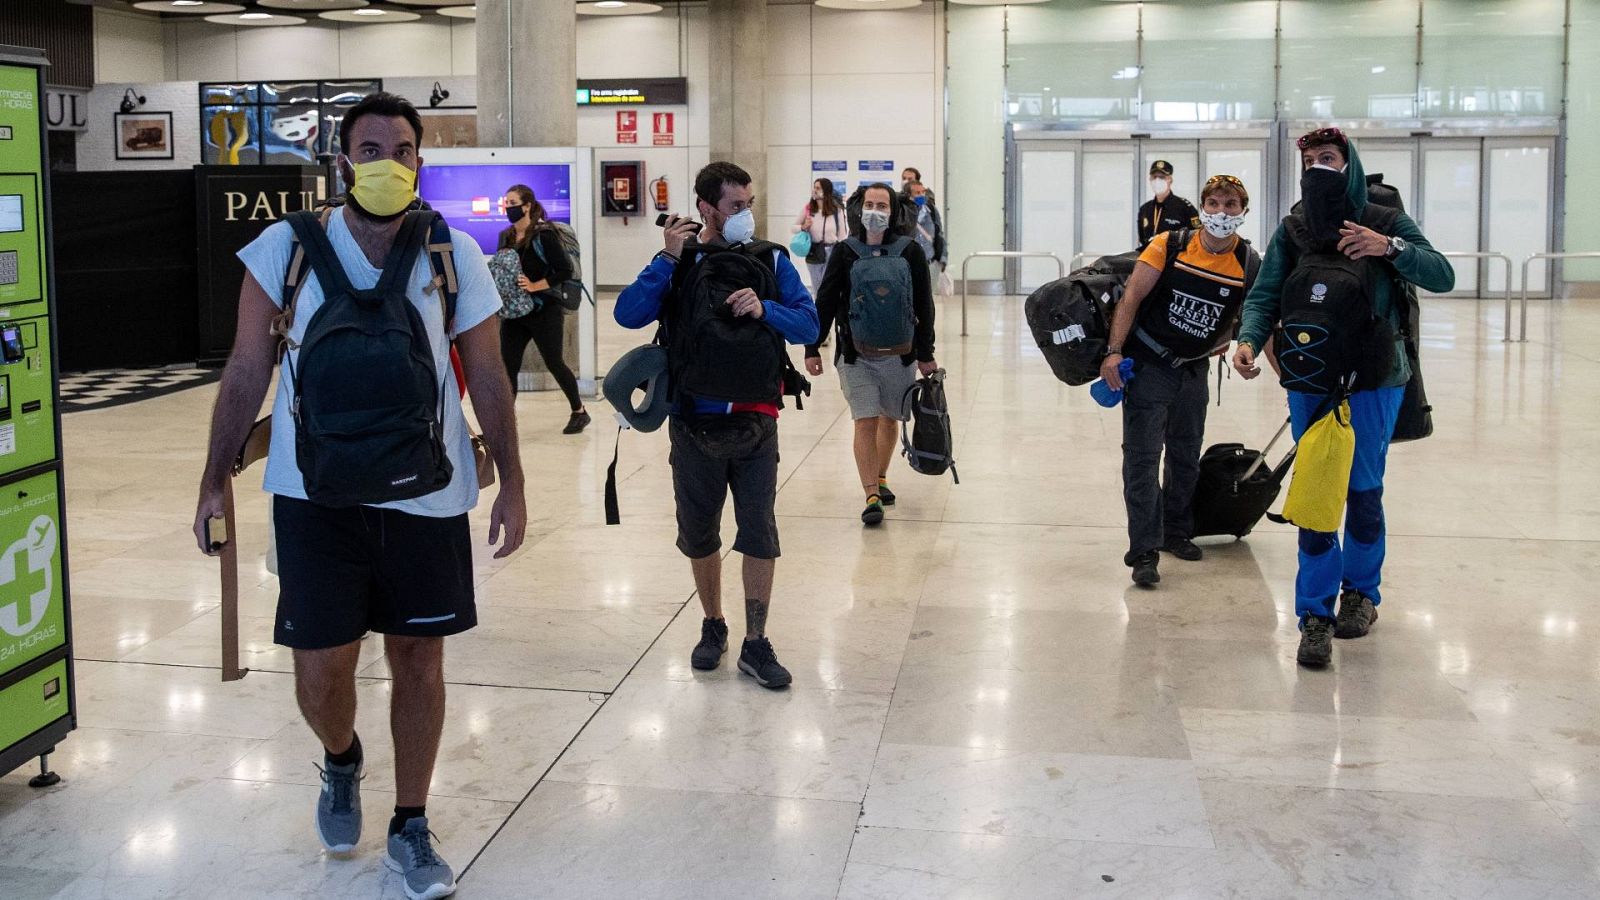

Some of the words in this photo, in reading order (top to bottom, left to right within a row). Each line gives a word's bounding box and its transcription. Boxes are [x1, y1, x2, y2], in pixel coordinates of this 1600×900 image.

[1169, 302, 1220, 328] DESERT
[1172, 292, 1223, 318] TITAN
[1168, 316, 1209, 339] GARMIN
[0, 644, 15, 661] 24
[19, 622, 57, 652] HORAS
